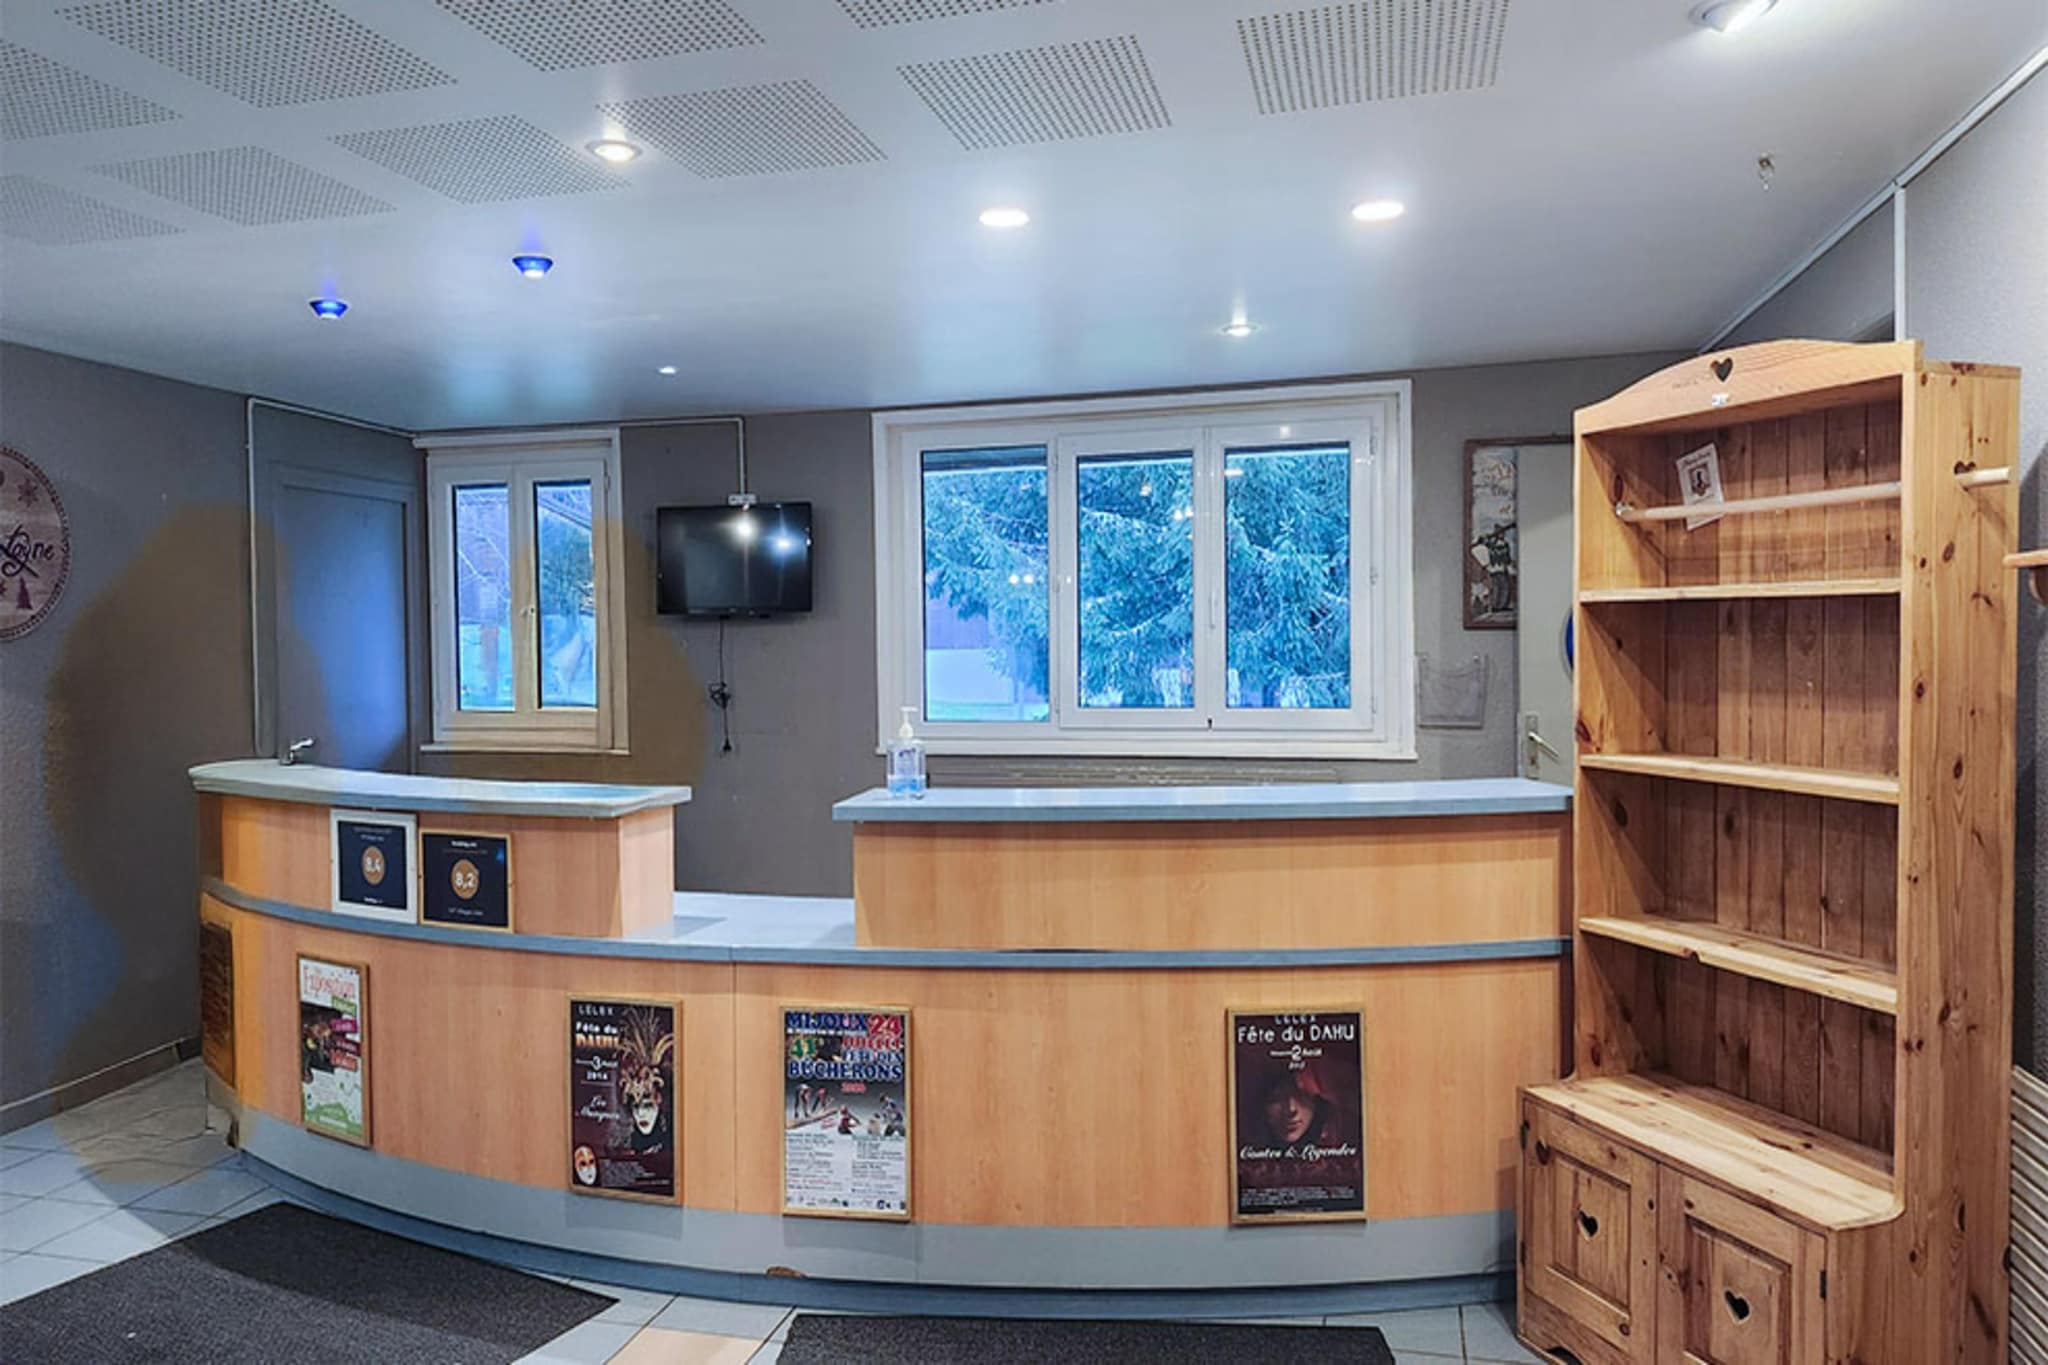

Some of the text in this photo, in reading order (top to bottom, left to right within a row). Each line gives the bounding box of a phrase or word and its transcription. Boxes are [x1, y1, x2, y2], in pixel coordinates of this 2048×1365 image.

[869, 1014, 901, 1036] 24
[1281, 1025, 1304, 1041] du
[1310, 1024, 1354, 1041] DAHU
